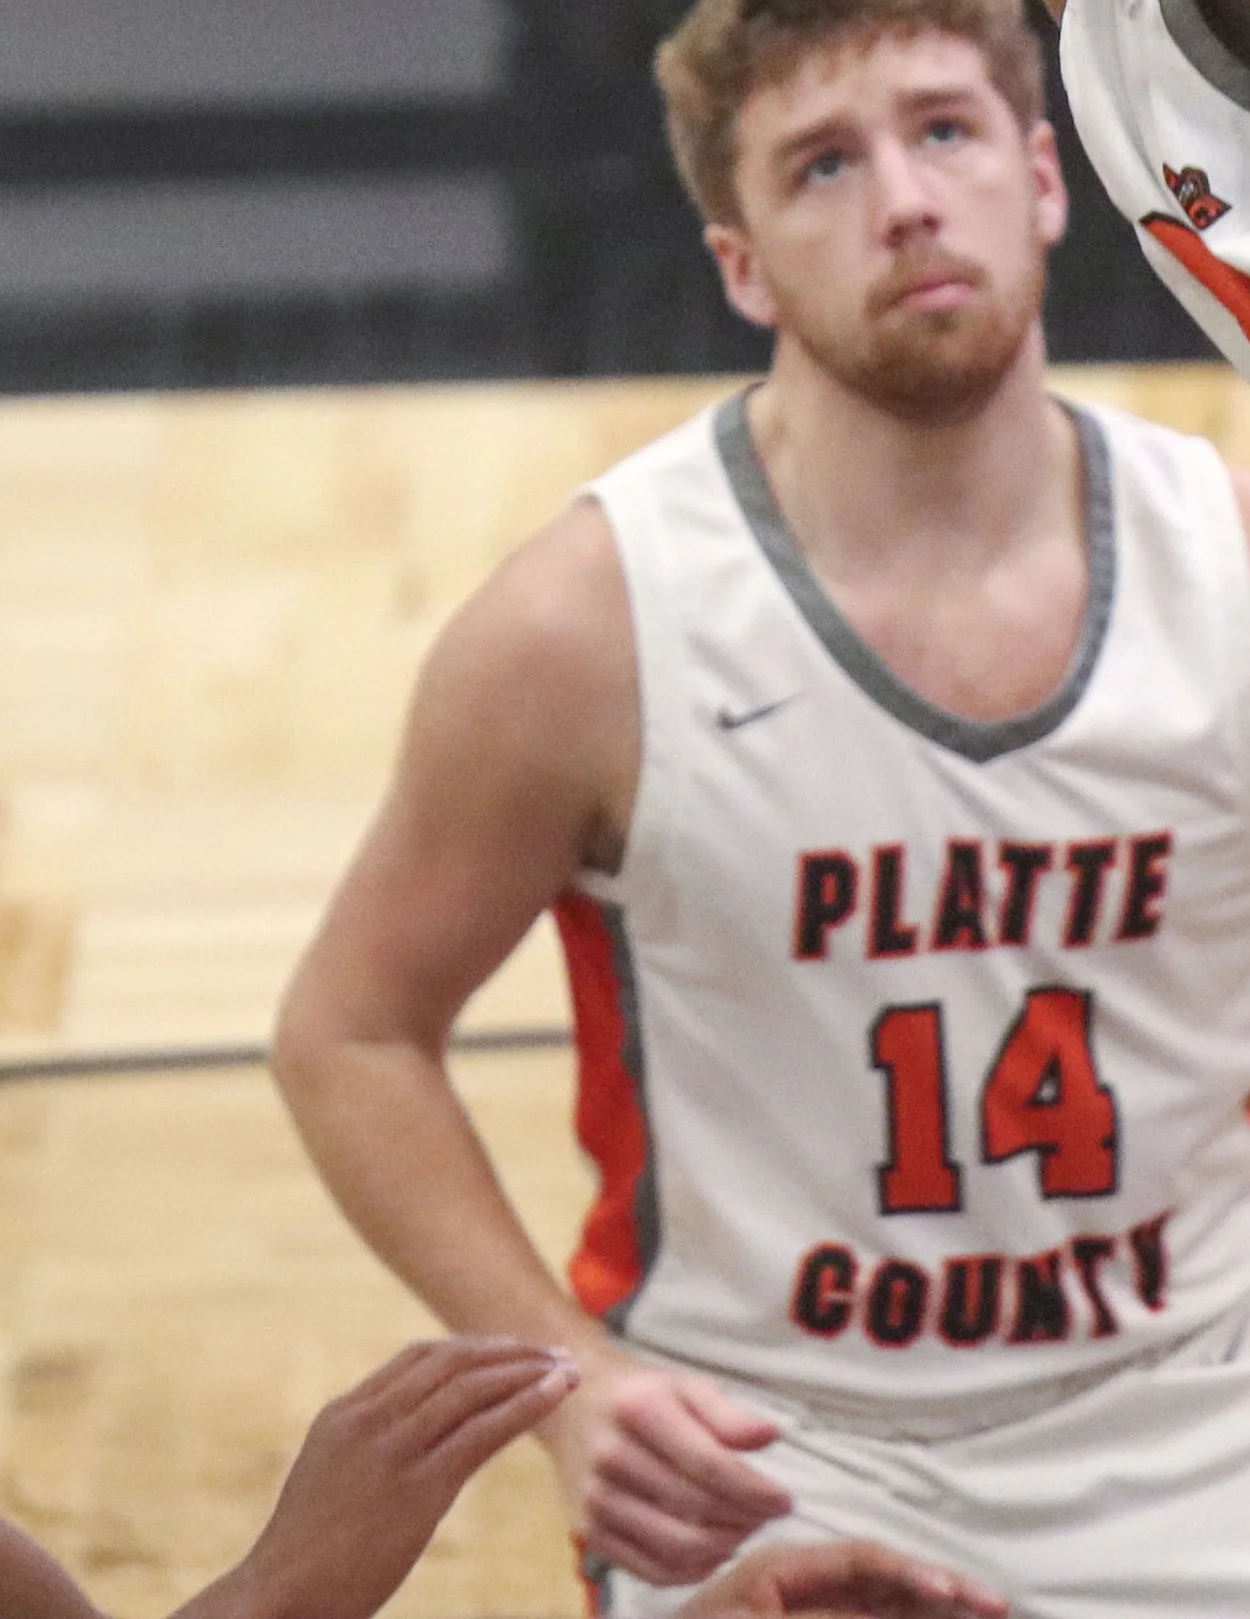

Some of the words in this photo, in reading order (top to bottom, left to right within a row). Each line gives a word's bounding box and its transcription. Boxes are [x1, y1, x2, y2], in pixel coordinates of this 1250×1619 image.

[793, 830, 1173, 961] PLATTE
[868, 986, 1119, 1215] 14
[791, 1209, 1176, 1348] COUNTY
